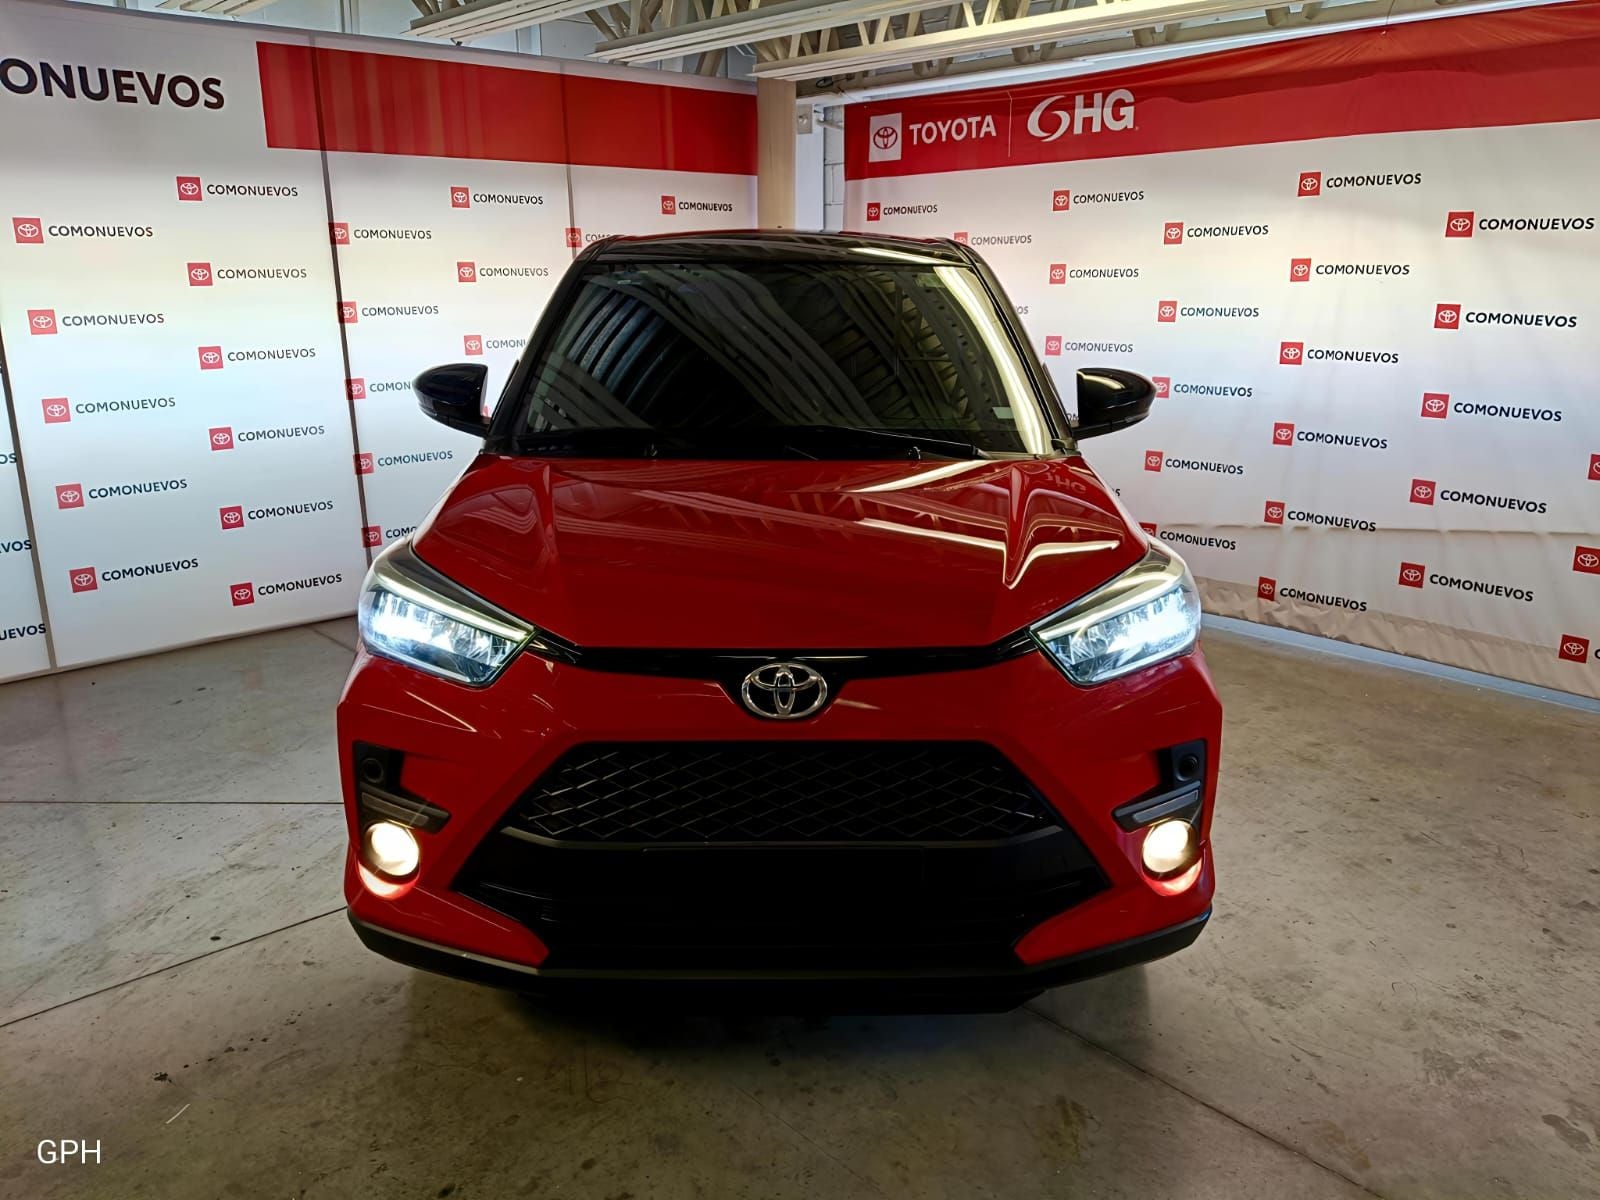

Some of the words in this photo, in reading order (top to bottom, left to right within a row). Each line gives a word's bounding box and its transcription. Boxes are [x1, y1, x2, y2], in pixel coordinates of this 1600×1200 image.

[0, 57, 225, 110] ONUEVOS
[910, 114, 997, 146] TOYOTA
[1326, 172, 1422, 189] COMONUEVOS
[206, 183, 299, 197] COMONUEVOS
[1072, 190, 1145, 205] COMONUEVOS
[472, 193, 544, 205] COMONUEVOS
[678, 201, 733, 212] COMONUEVOS
[883, 204, 938, 216] COMONUEVOS
[48, 225, 154, 238] COMONUEVOS
[1187, 225, 1269, 238] COMONUEVOS
[1478, 217, 1595, 231] COMONUEVOS
[353, 229, 432, 240] COMONUEVOS
[971, 234, 1032, 246] COMONUEVOS
[217, 268, 307, 280] COMONUEVOS
[479, 267, 549, 277] COMONUEVOS
[1069, 268, 1139, 279] COMONUEVOS
[1315, 264, 1410, 276] COMONUEVOS
[361, 305, 439, 317] COMONUEVOS
[1180, 307, 1260, 318] COMONUEVOS
[61, 313, 165, 327] COMONUEVOS
[1465, 311, 1577, 328] COMONUEVOS
[486, 339, 526, 349] COMON
[1064, 341, 1134, 353] COMONUEVOS
[227, 347, 316, 362] COMONUEVOS
[1307, 348, 1399, 364] COMONUEVOS
[1173, 383, 1253, 398] COMONUEVOS
[75, 397, 176, 414] COMONUEVOS
[1453, 402, 1562, 422] COMONUEVOS
[237, 425, 325, 442] COMONUEVOS
[1296, 431, 1388, 450] COMONUEVOS
[377, 450, 453, 467] COMONUEVOS
[1165, 458, 1244, 475] COMONUEVOS
[88, 478, 188, 499] COMONUEVOS
[1440, 489, 1548, 514] COMONUEVOS
[247, 500, 334, 520] COMONUEVOS
[1287, 510, 1377, 533] COMONUEVOS
[1160, 531, 1237, 551] COMONUEVOS
[101, 558, 199, 582] COMONUEVOS
[257, 573, 343, 596] COMONUEVOS
[1429, 573, 1534, 602] COMONUEVOS
[1278, 587, 1368, 612] COMONUEVOS
